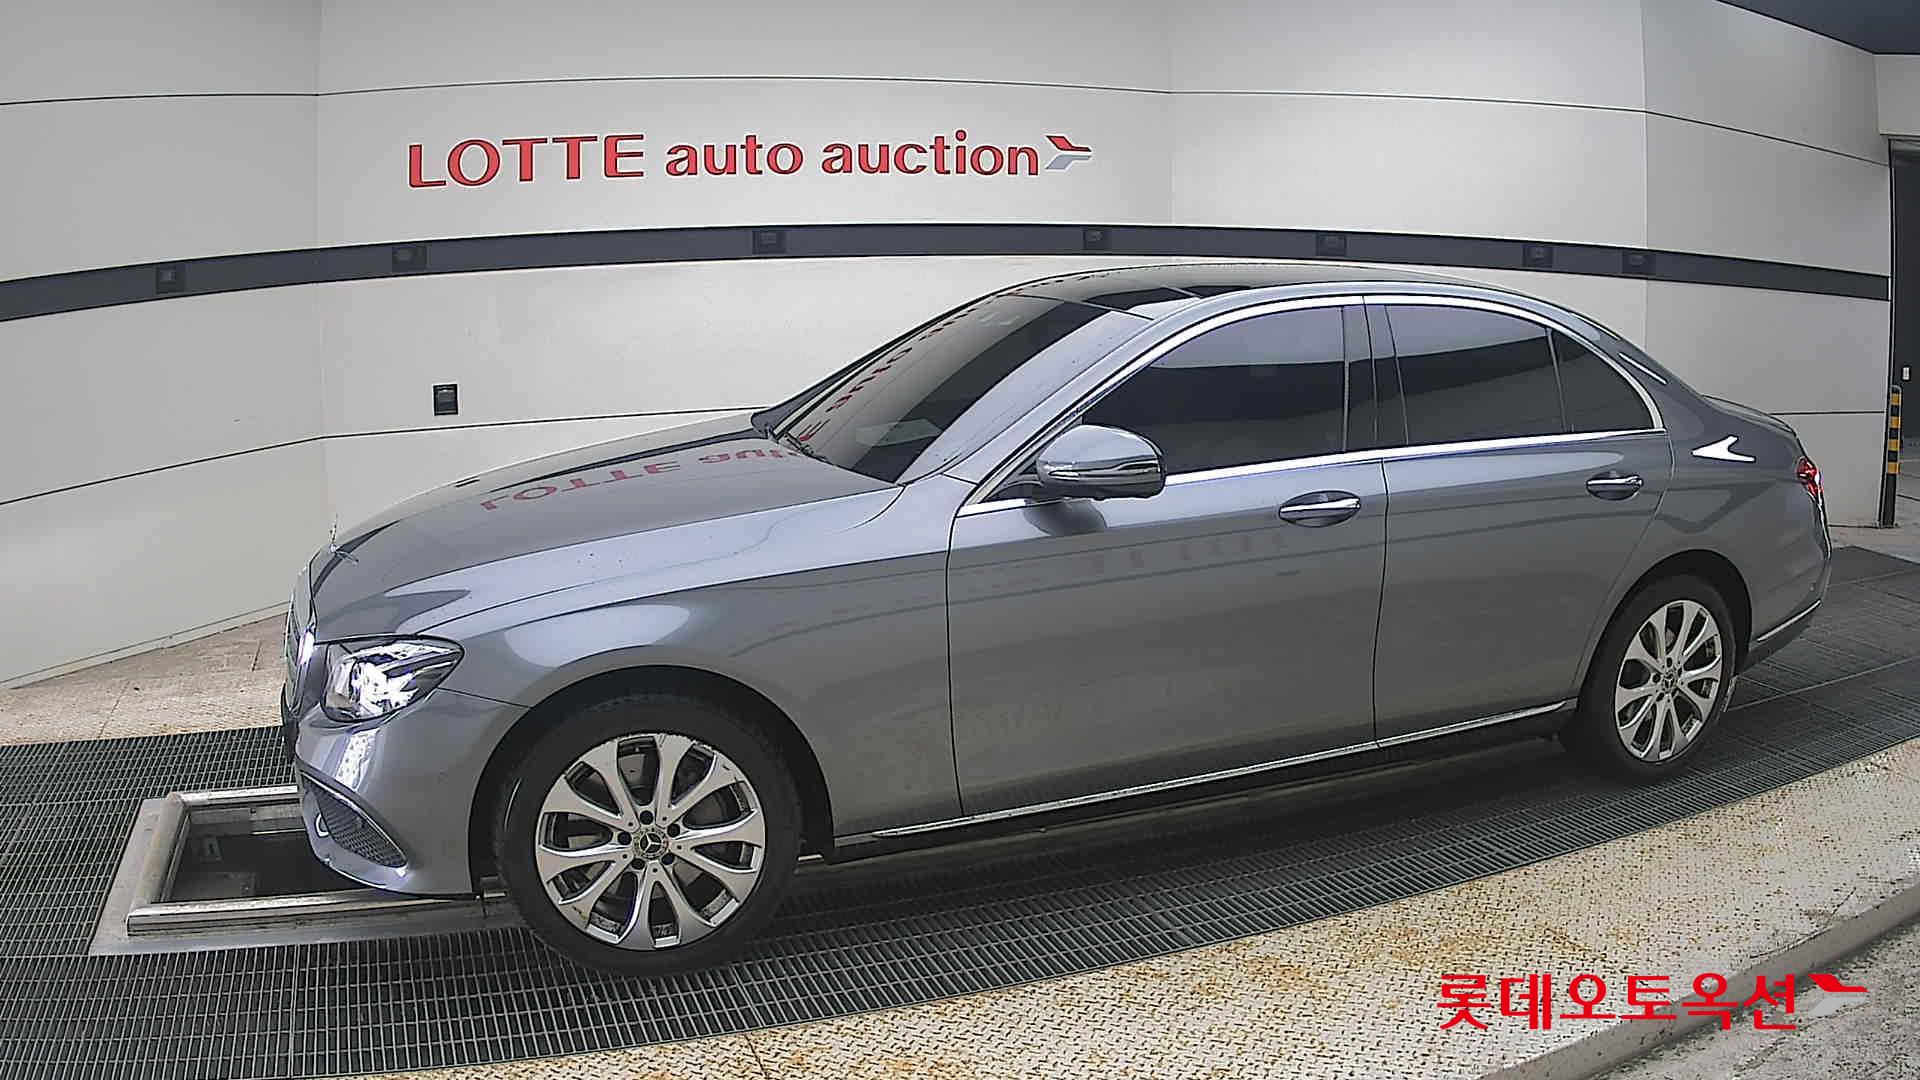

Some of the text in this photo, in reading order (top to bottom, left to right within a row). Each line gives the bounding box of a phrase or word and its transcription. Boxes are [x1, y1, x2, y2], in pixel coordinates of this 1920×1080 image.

[408, 130, 1039, 188] LOTTE auto auction
